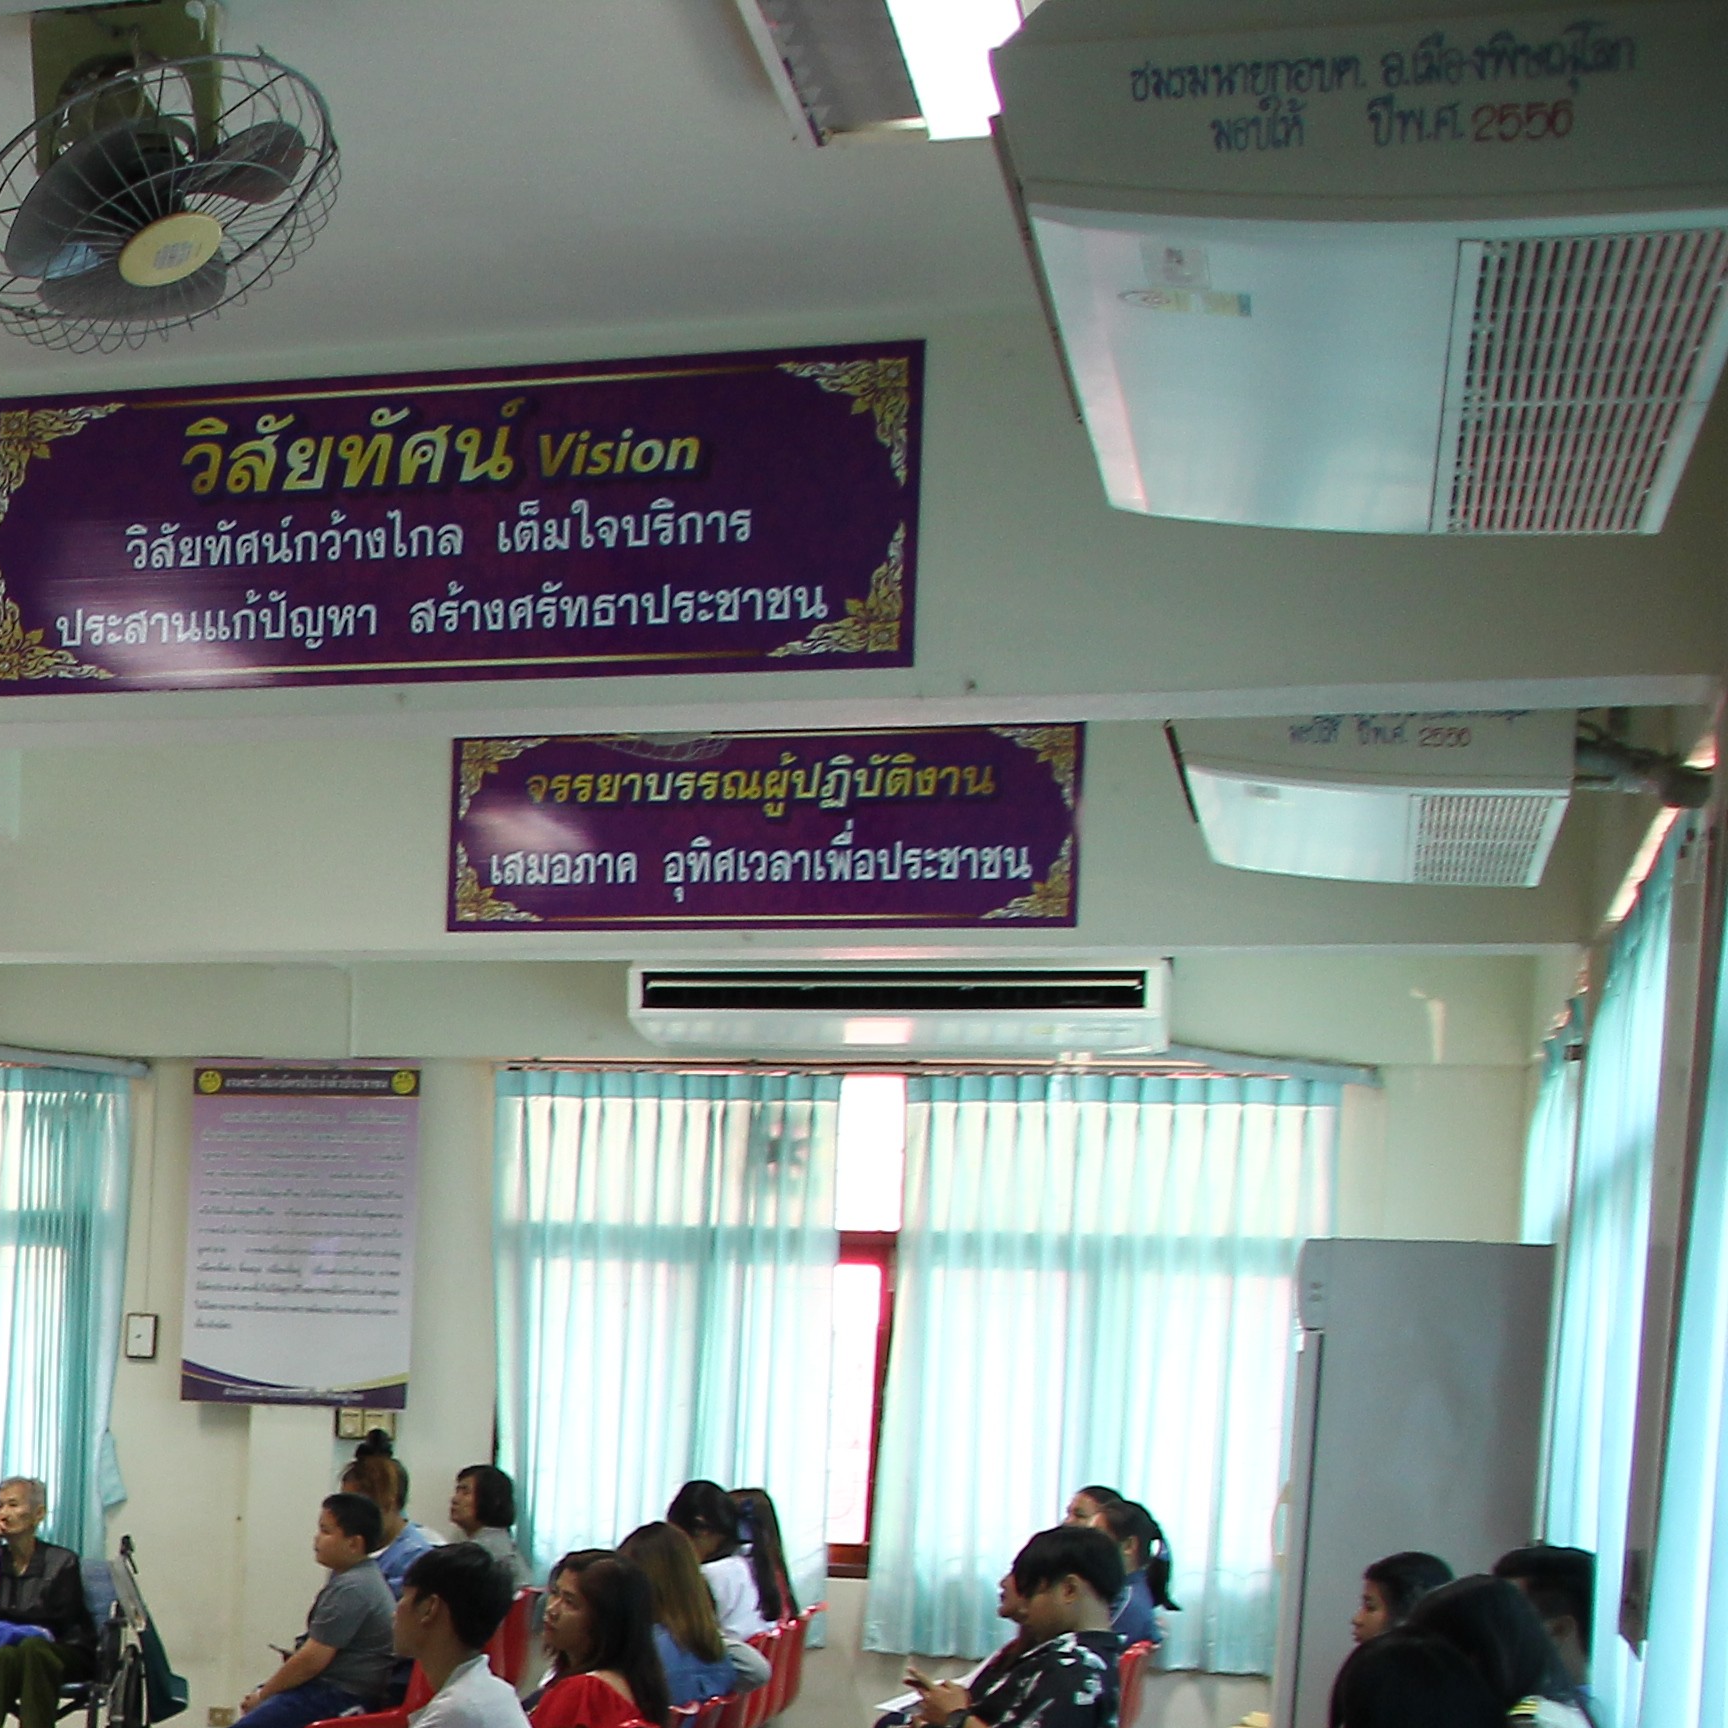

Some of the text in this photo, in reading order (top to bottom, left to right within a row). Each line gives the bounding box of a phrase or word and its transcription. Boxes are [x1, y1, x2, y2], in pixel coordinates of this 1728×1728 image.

[182, 397, 701, 499] วิสัยทัศน์ Vision
[125, 497, 753, 571] วิสัยทัศน์กว้างไกล เต็มใจบริการ
[56, 578, 830, 649] ประสานแก้ปัญหา สร้างศรัทธาประชาชน
[526, 752, 996, 818] จรรยาบรรณผู้ปฏิบัติงาน
[489, 818, 1033, 903] เสมอภาค อุทิศเวลาเพื่อประชาชน
